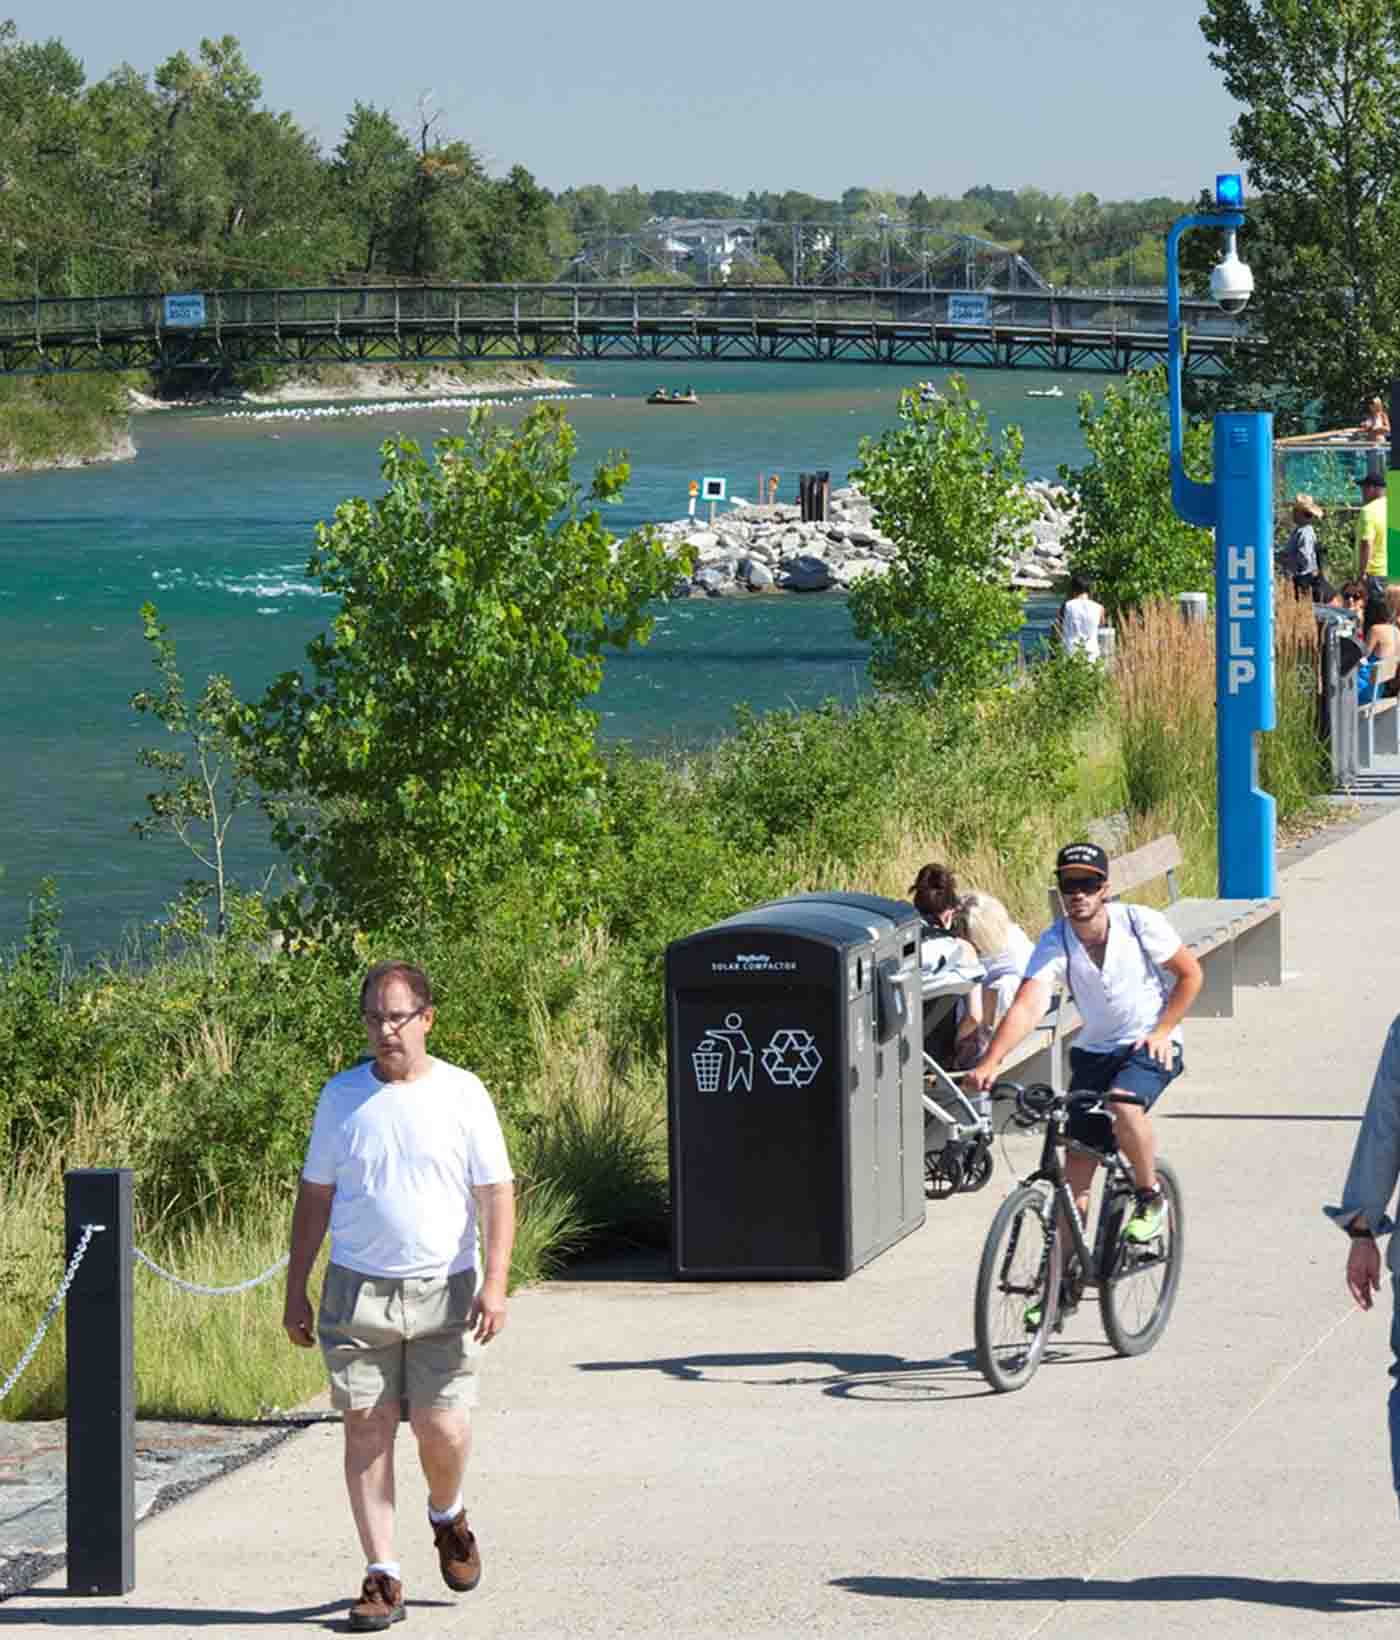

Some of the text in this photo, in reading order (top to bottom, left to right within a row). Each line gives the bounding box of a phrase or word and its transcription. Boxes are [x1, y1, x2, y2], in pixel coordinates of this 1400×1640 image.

[1227, 546, 1256, 694] HELP
[711, 961, 796, 971] SOLAR COMPACTOR
